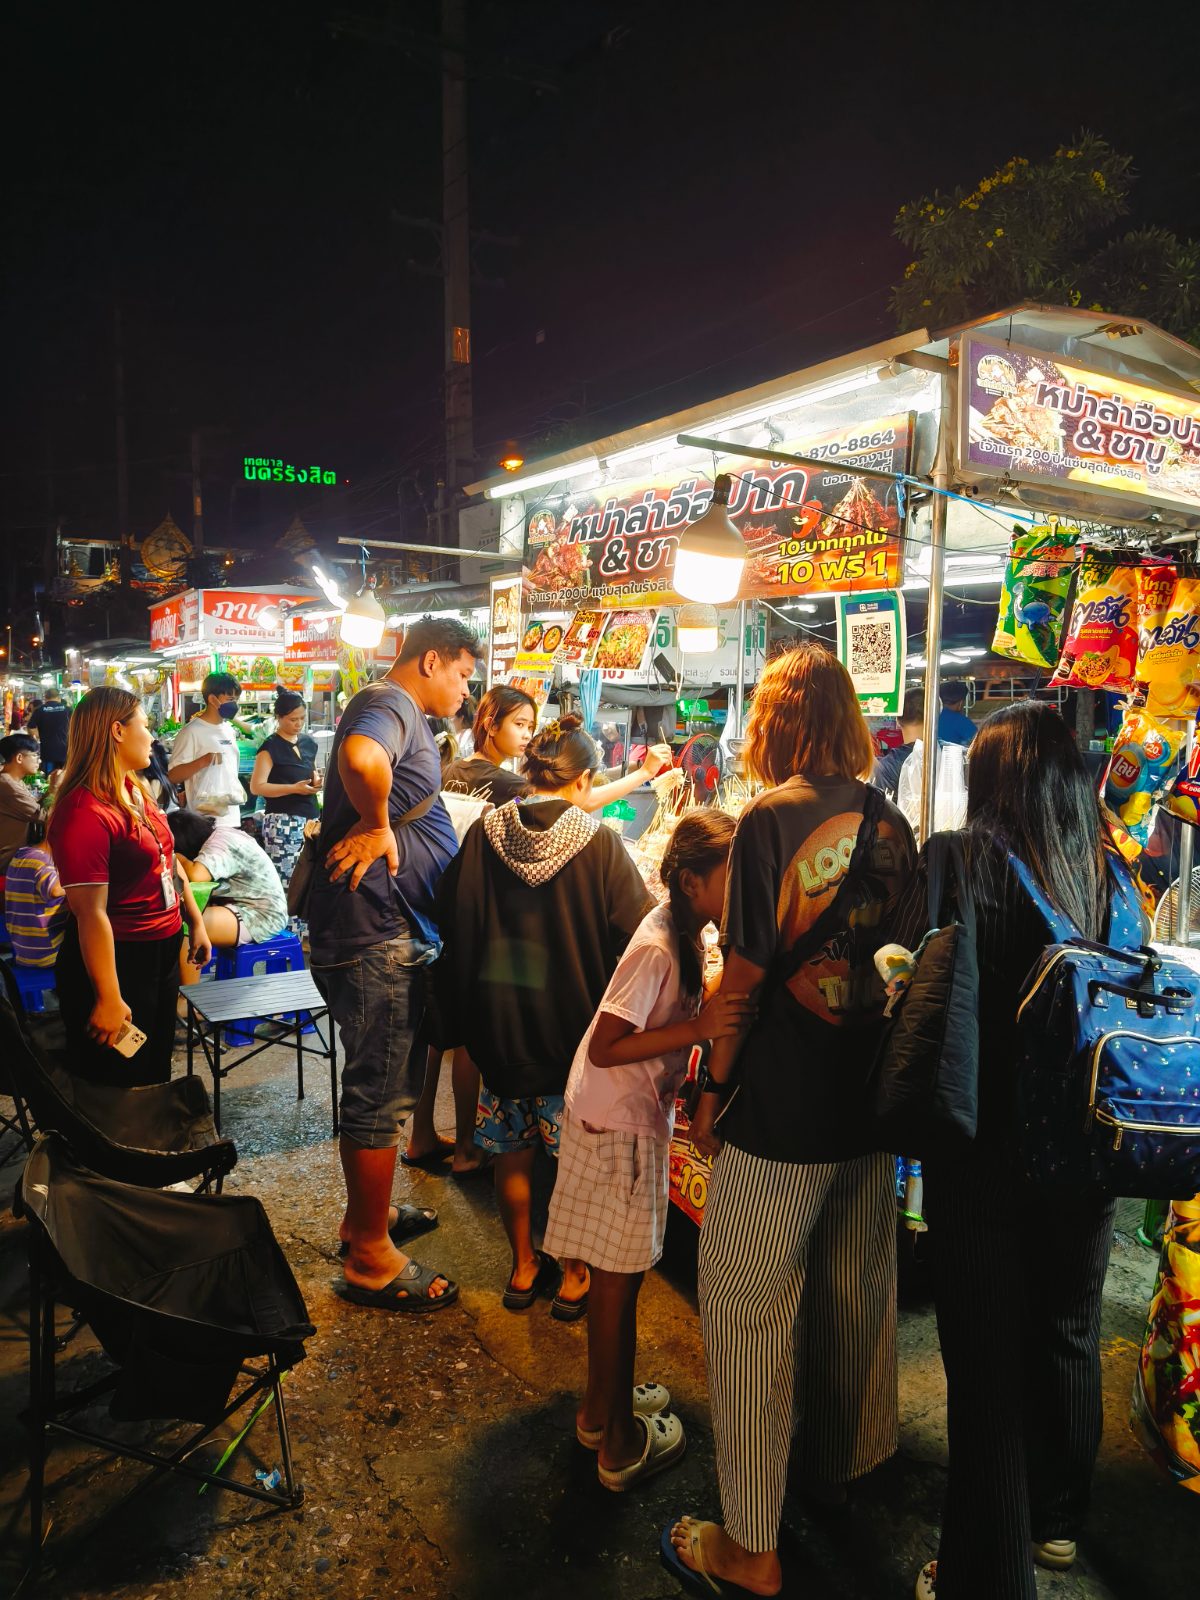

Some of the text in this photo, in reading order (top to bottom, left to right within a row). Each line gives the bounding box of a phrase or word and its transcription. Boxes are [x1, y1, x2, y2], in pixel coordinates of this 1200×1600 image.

[244, 457, 283, 467] เทศบาล
[1076, 420, 1166, 474] & ชาบู
[244, 464, 336, 485] นครรังสิต
[602, 536, 679, 574] & ชา
[777, 552, 888, 585] 10 ฟรี 1
[1112, 756, 1139, 780] เลย์
[681, 1163, 708, 1209] 10
